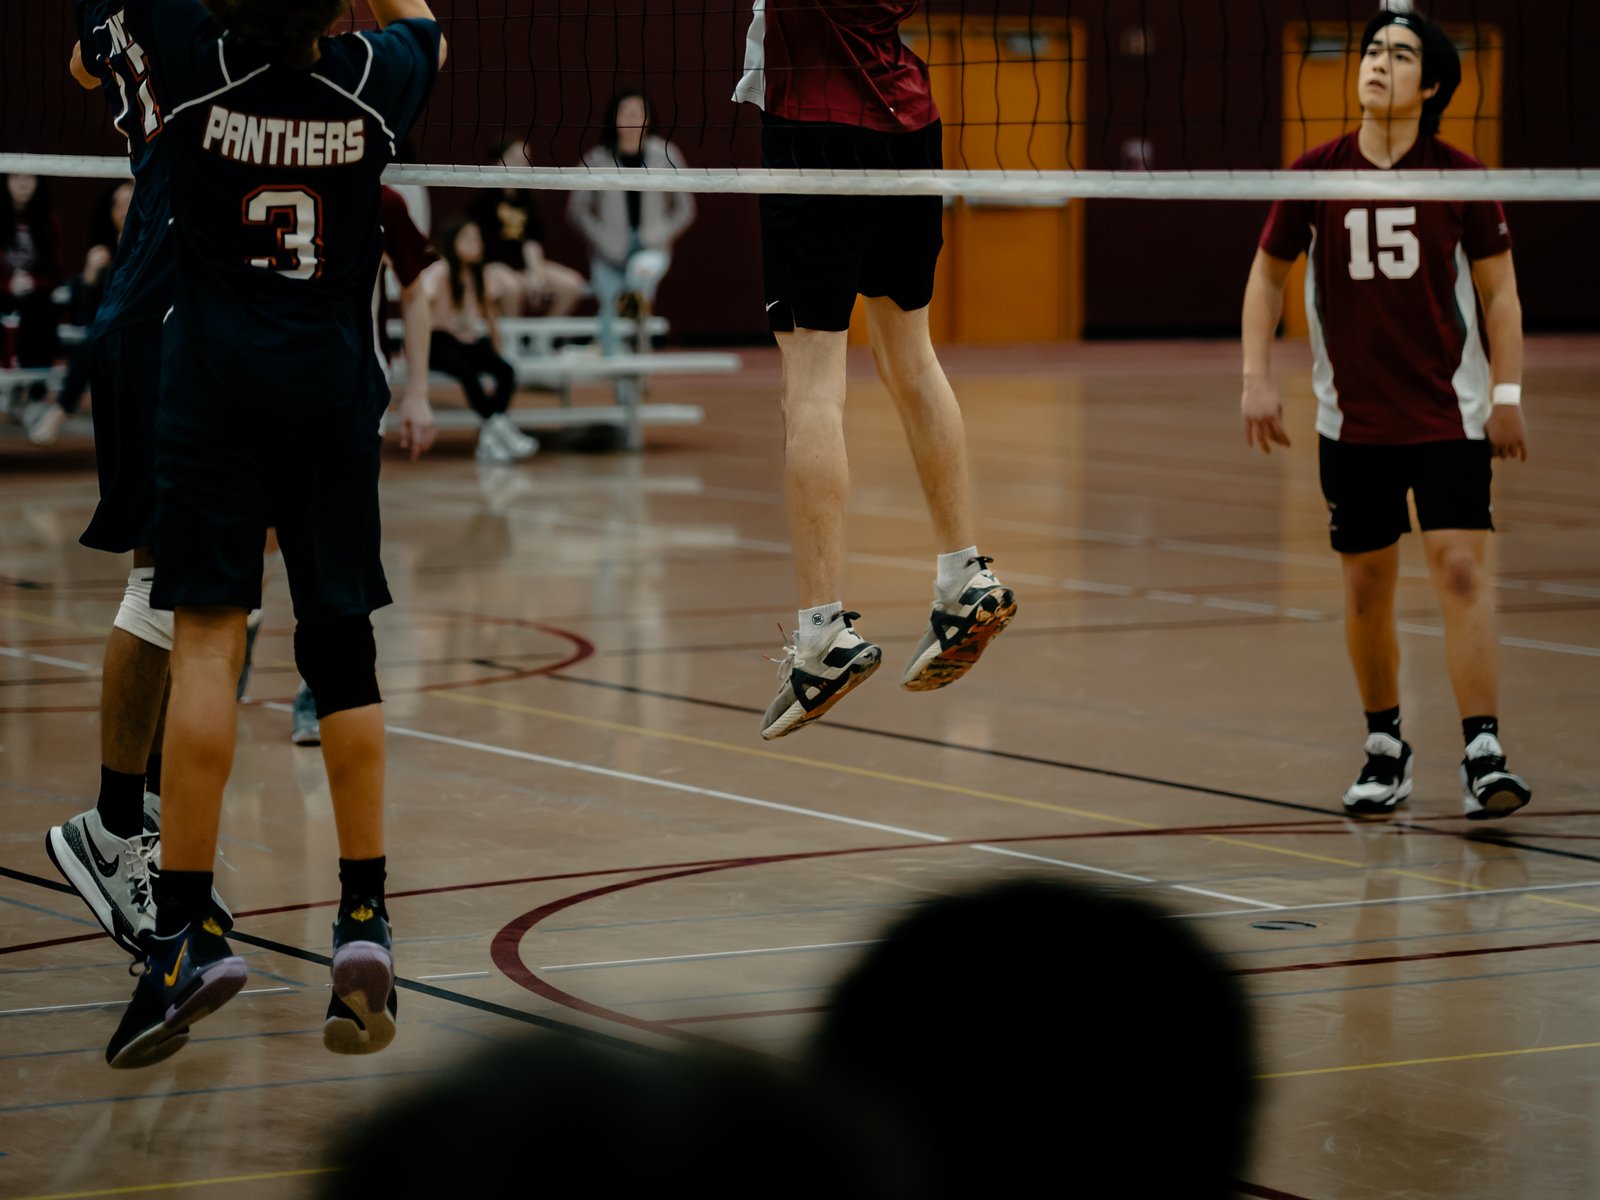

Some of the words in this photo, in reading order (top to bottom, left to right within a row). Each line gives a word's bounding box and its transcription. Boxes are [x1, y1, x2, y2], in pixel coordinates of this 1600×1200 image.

[202, 104, 365, 167] PANTHERS
[241, 184, 324, 280] 3
[1344, 206, 1420, 280] 15
